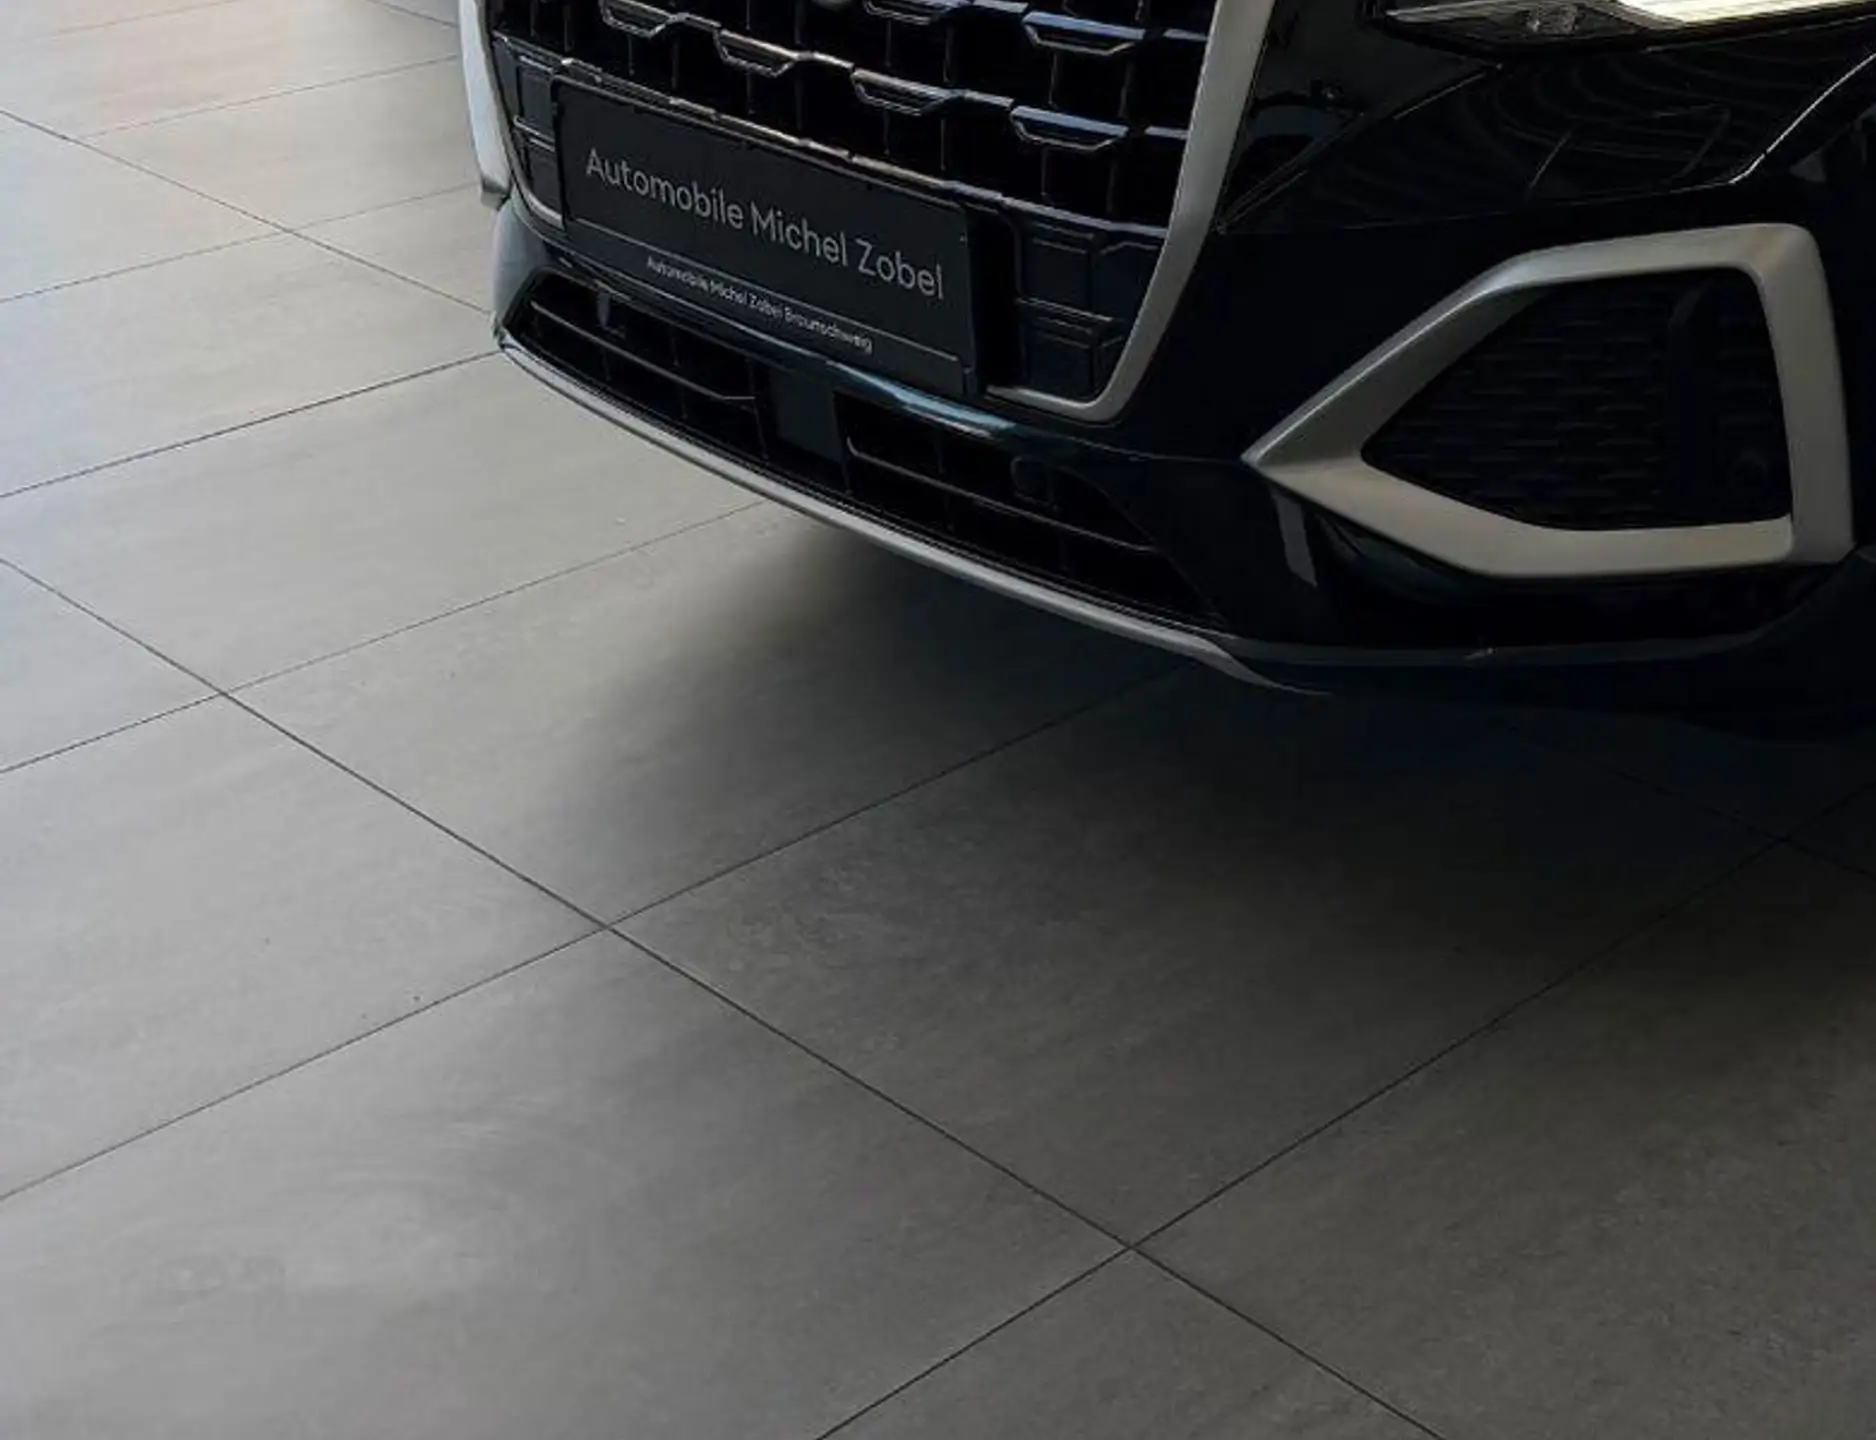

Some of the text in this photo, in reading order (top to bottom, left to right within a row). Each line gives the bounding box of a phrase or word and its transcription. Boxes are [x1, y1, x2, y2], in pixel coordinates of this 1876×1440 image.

[586, 147, 944, 299] Automobile Michel Zobel
[710, 279, 748, 306] Michel
[750, 293, 783, 319] Zobel
